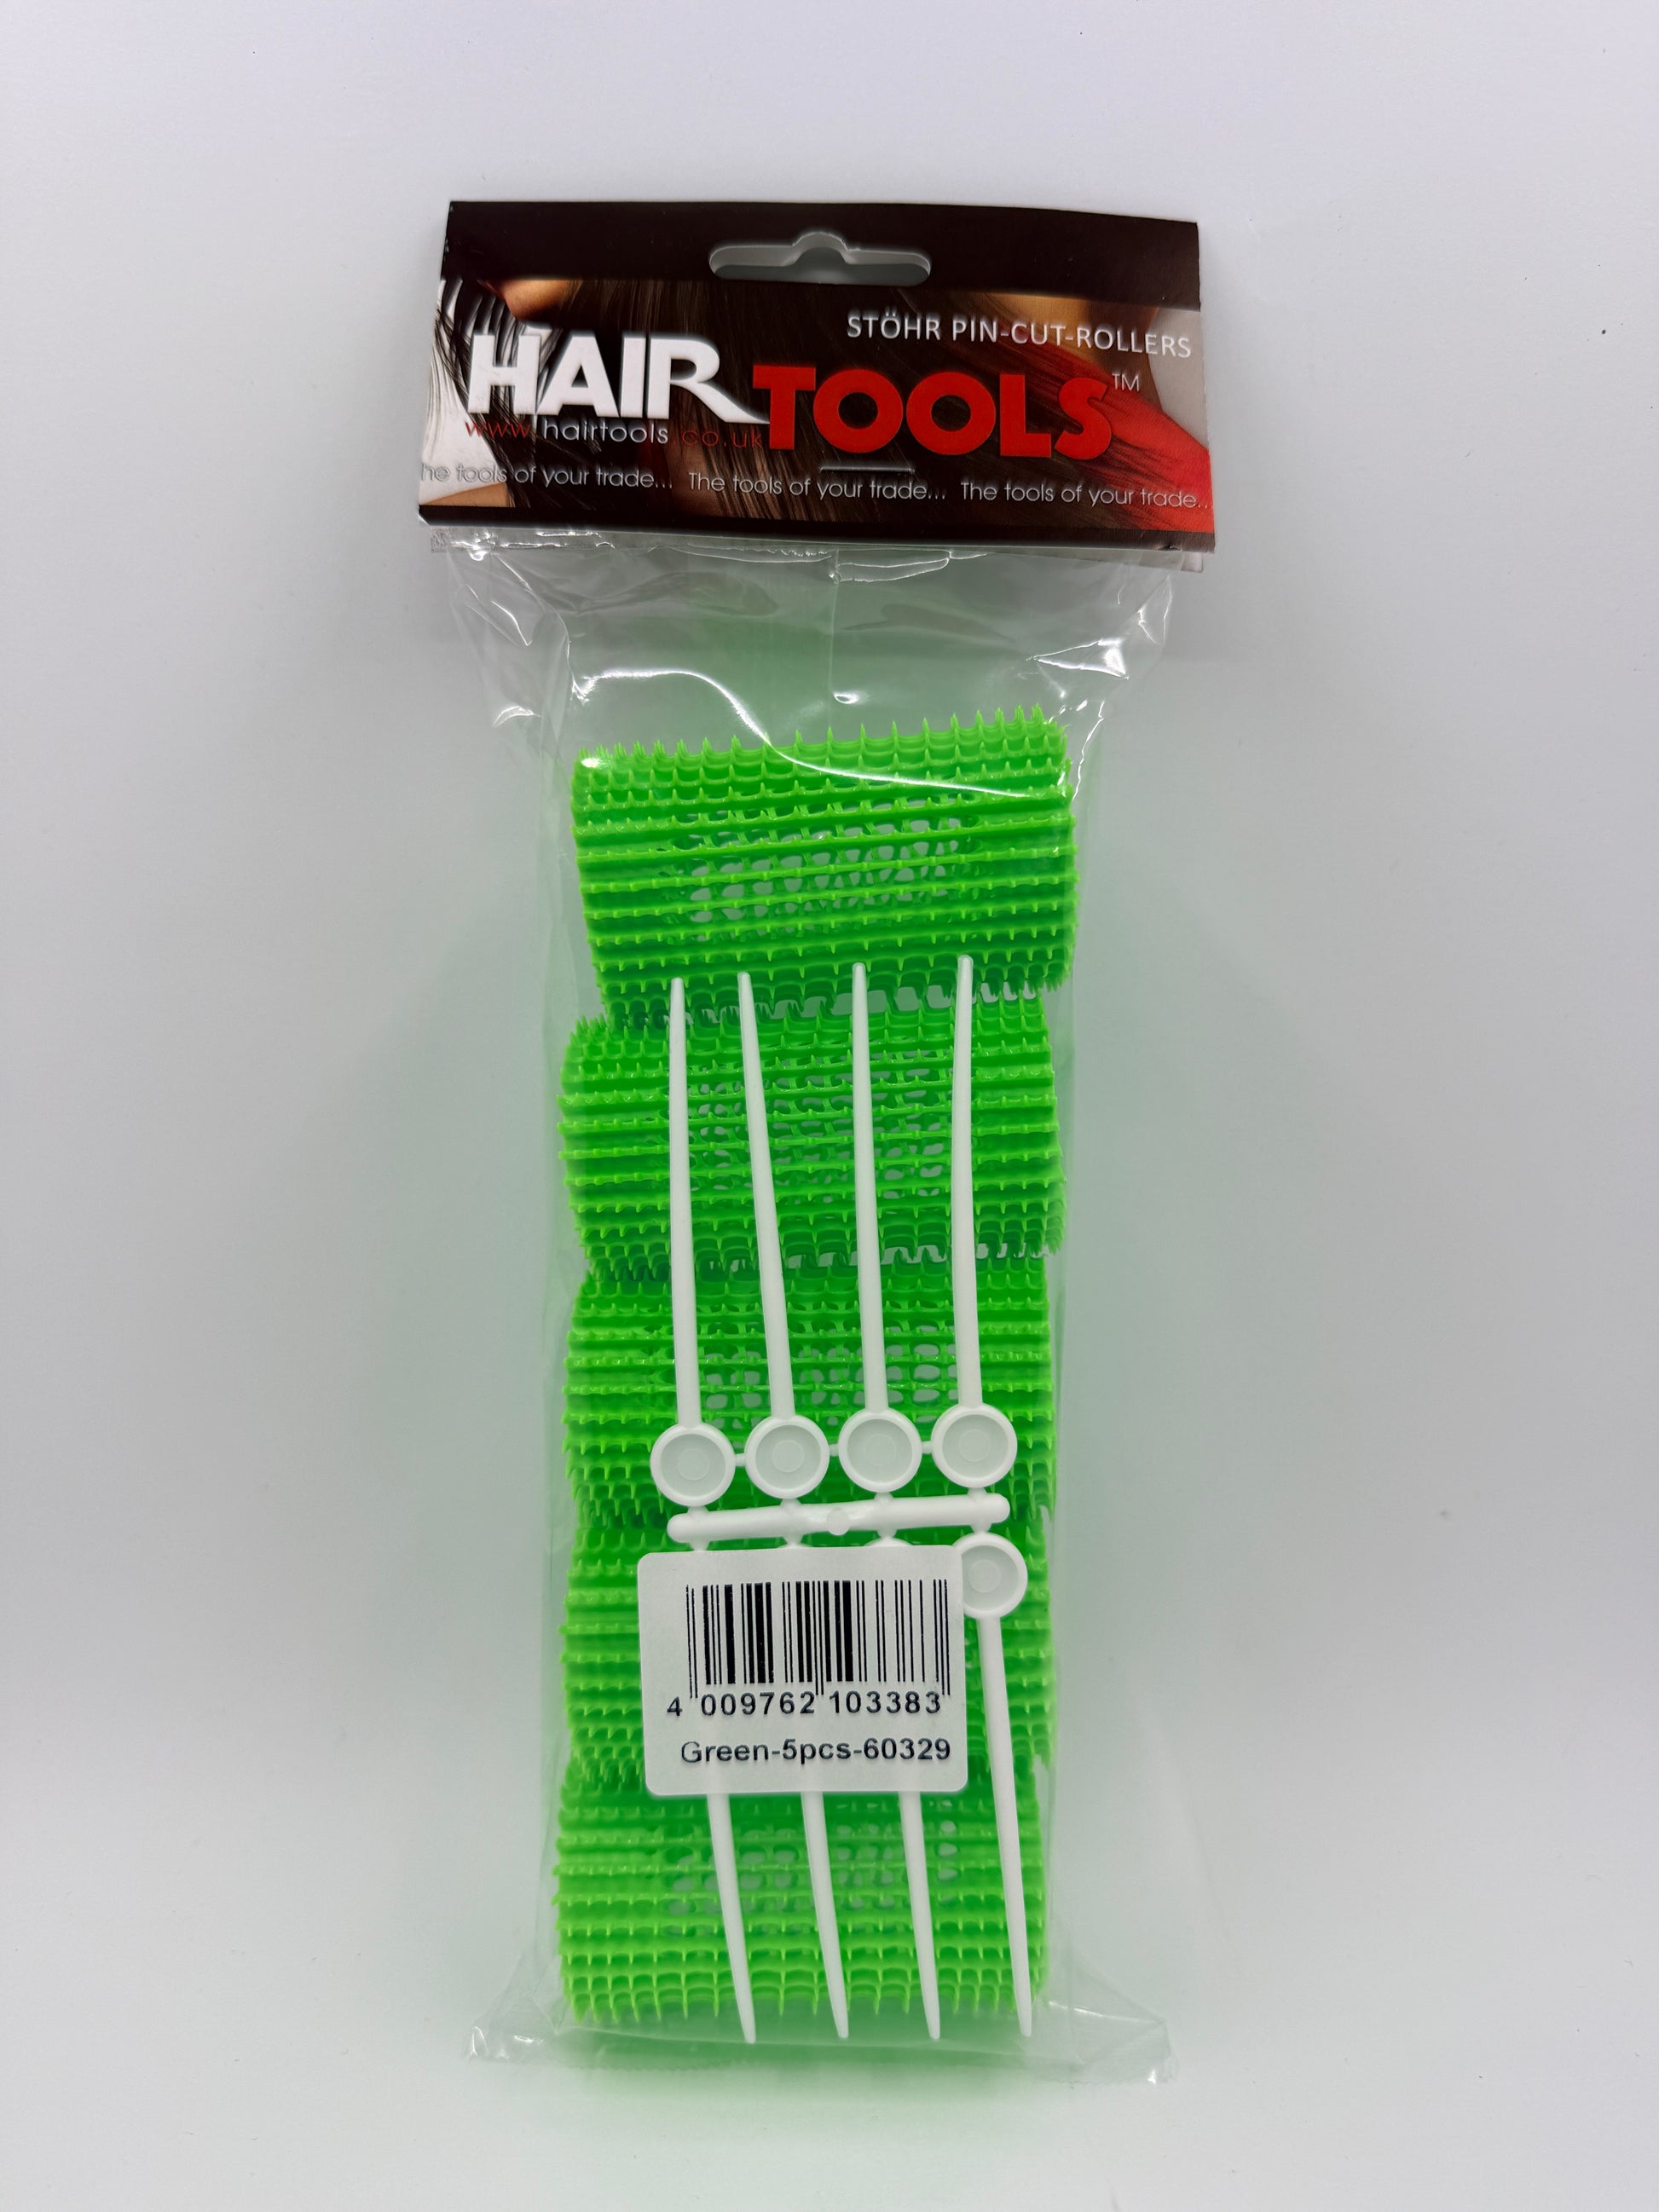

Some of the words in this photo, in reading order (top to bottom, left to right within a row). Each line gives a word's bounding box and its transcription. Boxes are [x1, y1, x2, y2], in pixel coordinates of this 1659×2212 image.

[847, 311, 940, 341] STÖHR
[951, 316, 1192, 358] PIN-CUT-ROLLERS
[467, 334, 771, 424] HAIR
[753, 364, 1113, 460] TOOLS
[420, 463, 450, 483] he
[456, 463, 507, 483] tools
[514, 465, 537, 483] of
[542, 471, 590, 488] your
[596, 468, 673, 489] trade...
[688, 471, 725, 491] The
[733, 475, 783, 494] tools
[789, 479, 811, 496] of
[817, 482, 864, 500] your
[870, 479, 946, 500] trade...
[960, 482, 997, 501] The
[1003, 482, 1055, 503] tools
[1061, 485, 1083, 503] of
[1089, 489, 1134, 508] your
[667, 1696, 683, 1717] 4
[701, 1691, 815, 1717] 009762
[829, 1690, 941, 1714] 103383
[681, 1737, 951, 1764] Green-5pcs-60329
